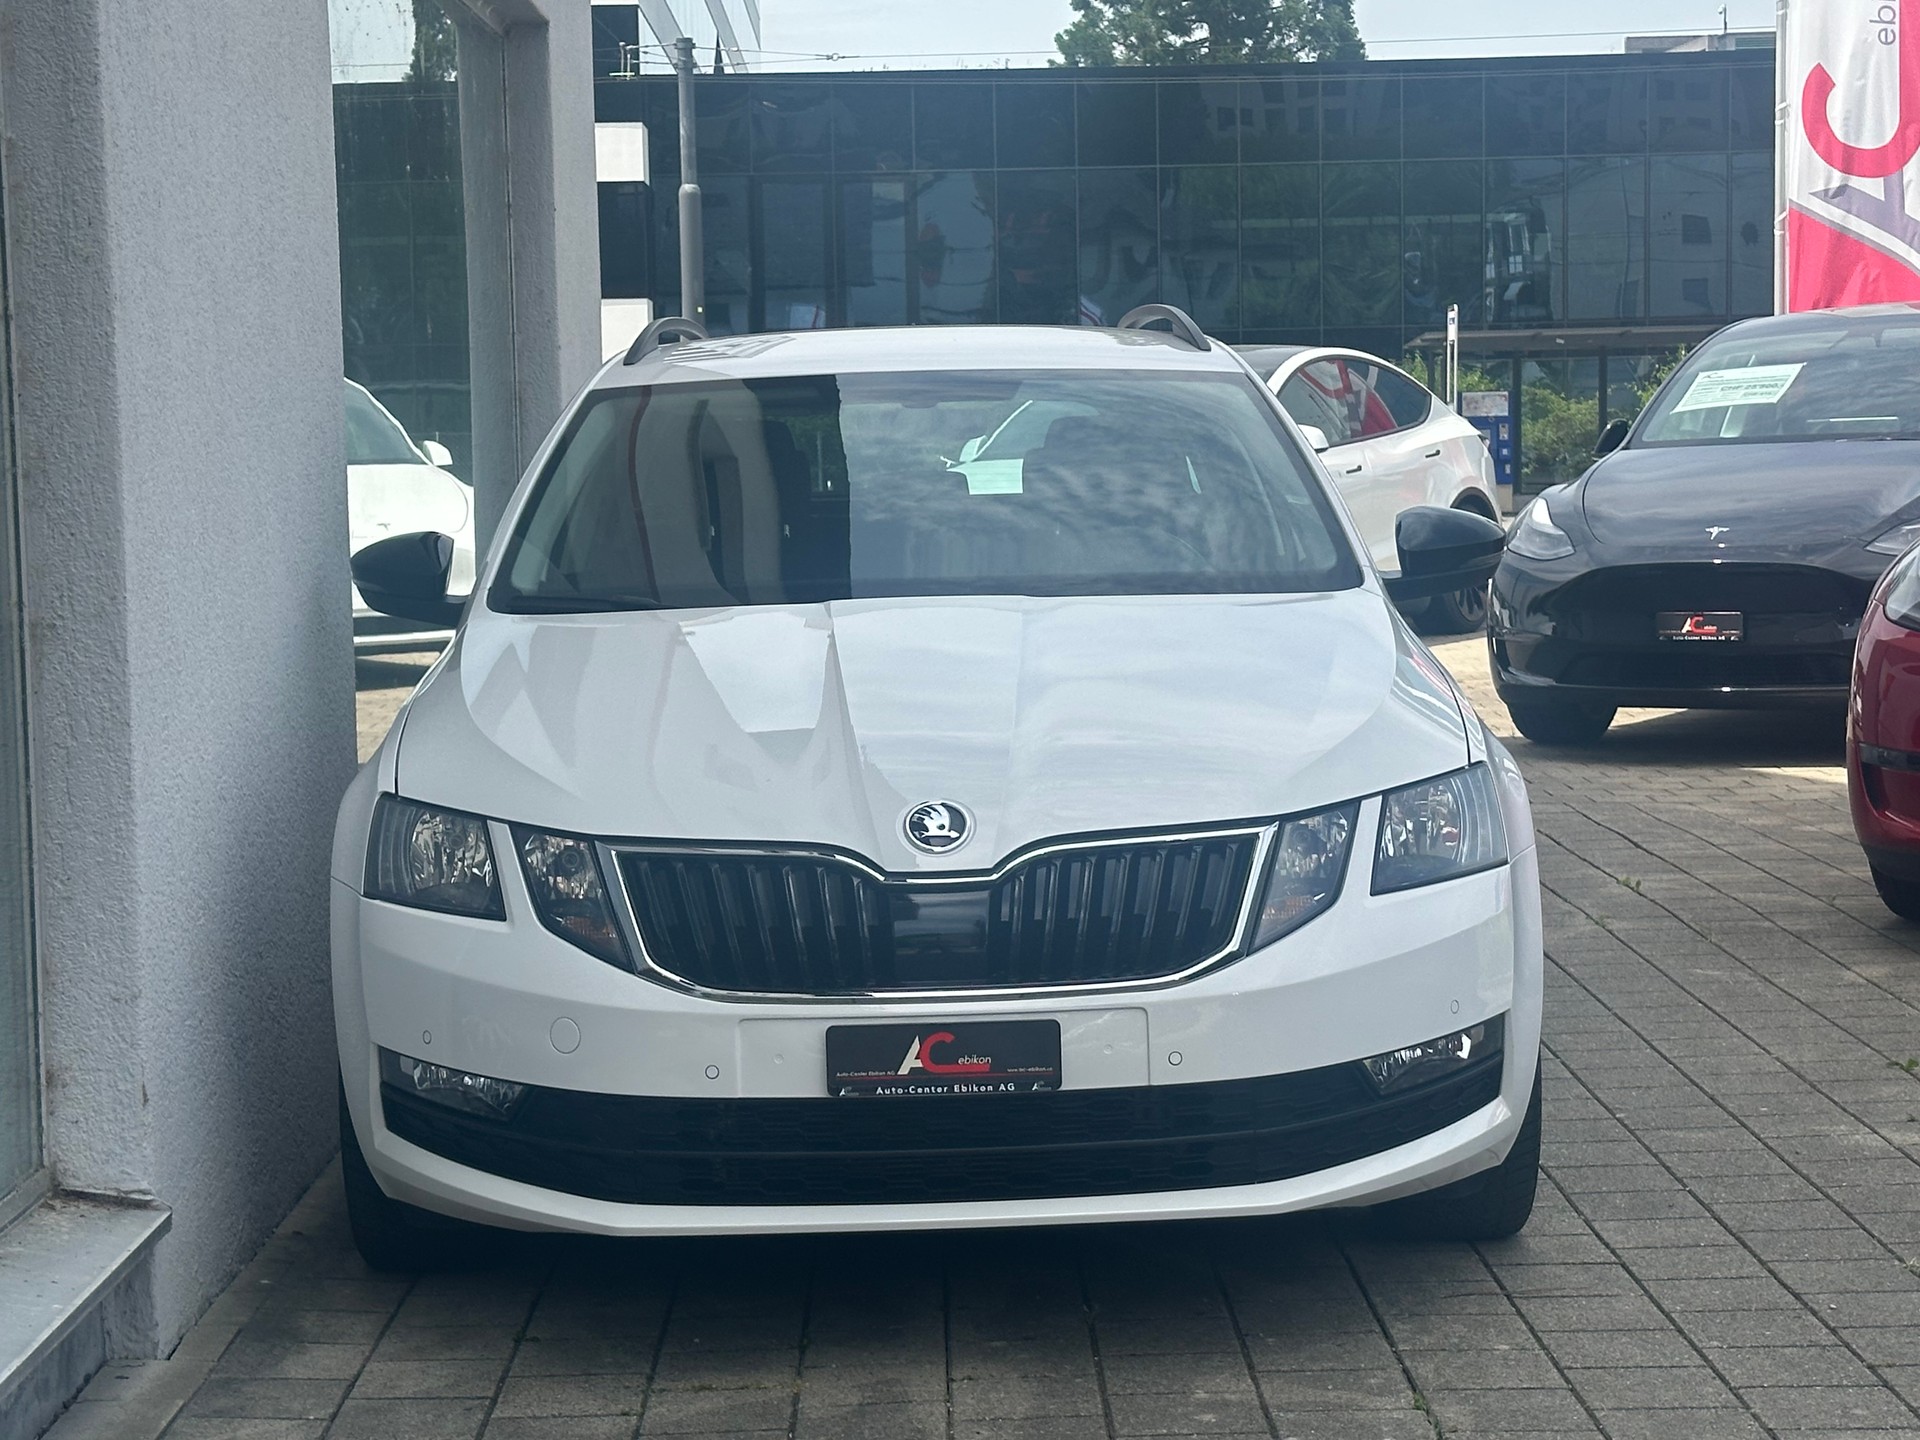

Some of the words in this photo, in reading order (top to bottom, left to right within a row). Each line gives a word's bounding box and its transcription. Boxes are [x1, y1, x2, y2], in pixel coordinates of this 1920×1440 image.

[957, 1054, 992, 1065] ebikon
[876, 1086, 948, 1095] Auto-Center
[953, 1084, 993, 1093] Ebikon
[999, 1082, 1015, 1092] AG
